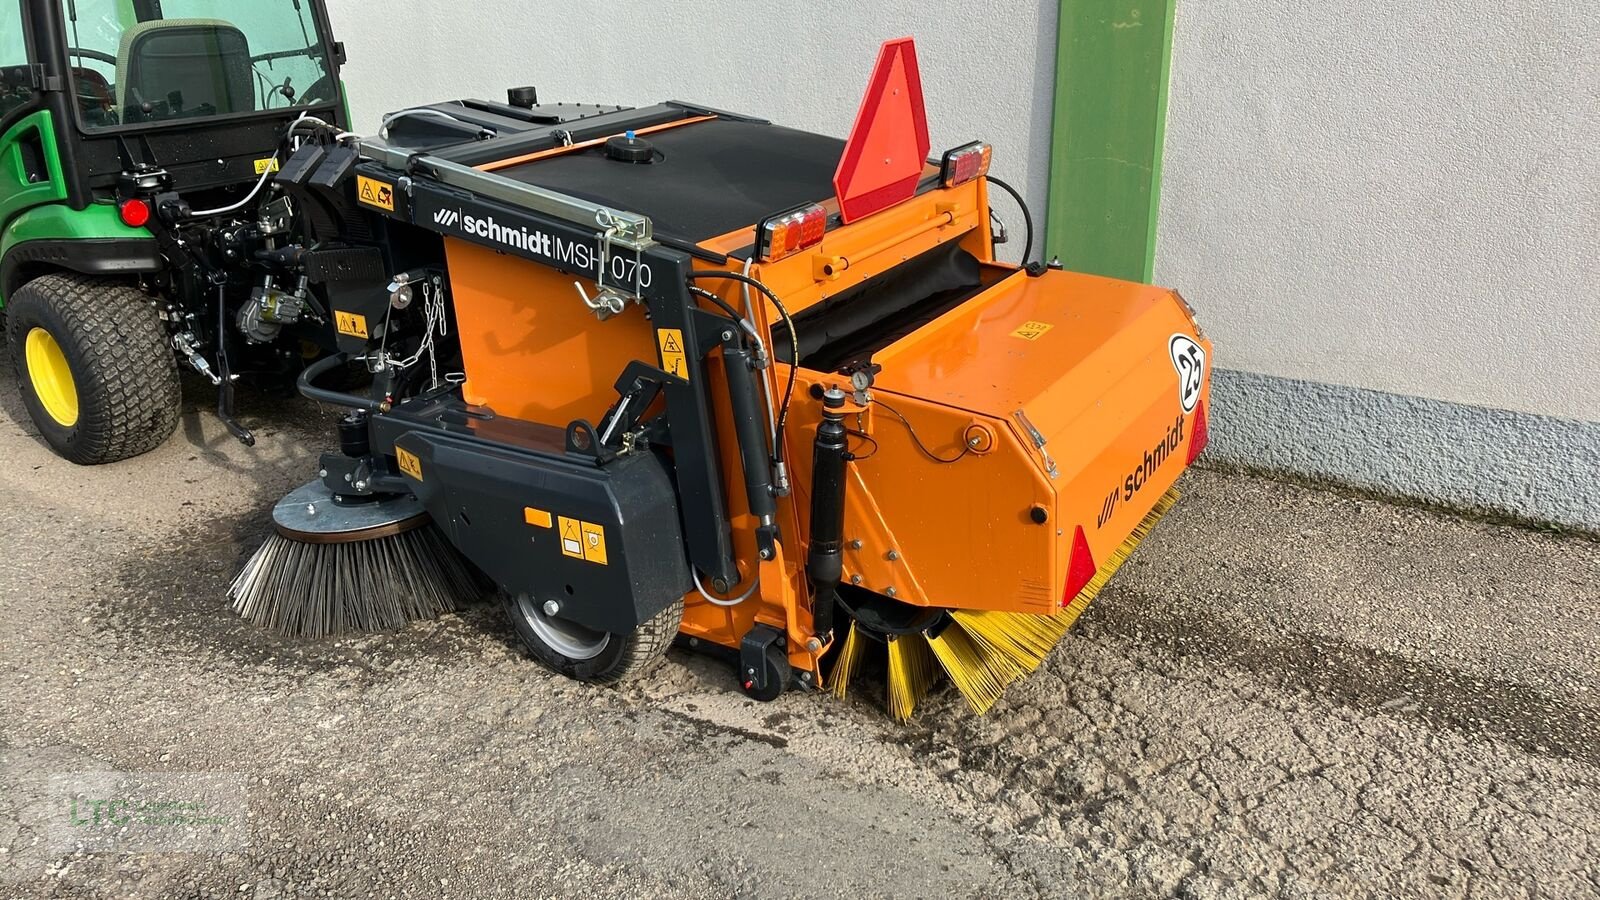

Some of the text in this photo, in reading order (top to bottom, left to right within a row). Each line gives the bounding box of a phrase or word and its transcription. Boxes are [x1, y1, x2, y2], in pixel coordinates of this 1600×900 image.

[463, 214, 550, 257] schmidt
[611, 256, 652, 288] 070
[1178, 344, 1202, 401] 25
[1124, 415, 1185, 502] schmidt
